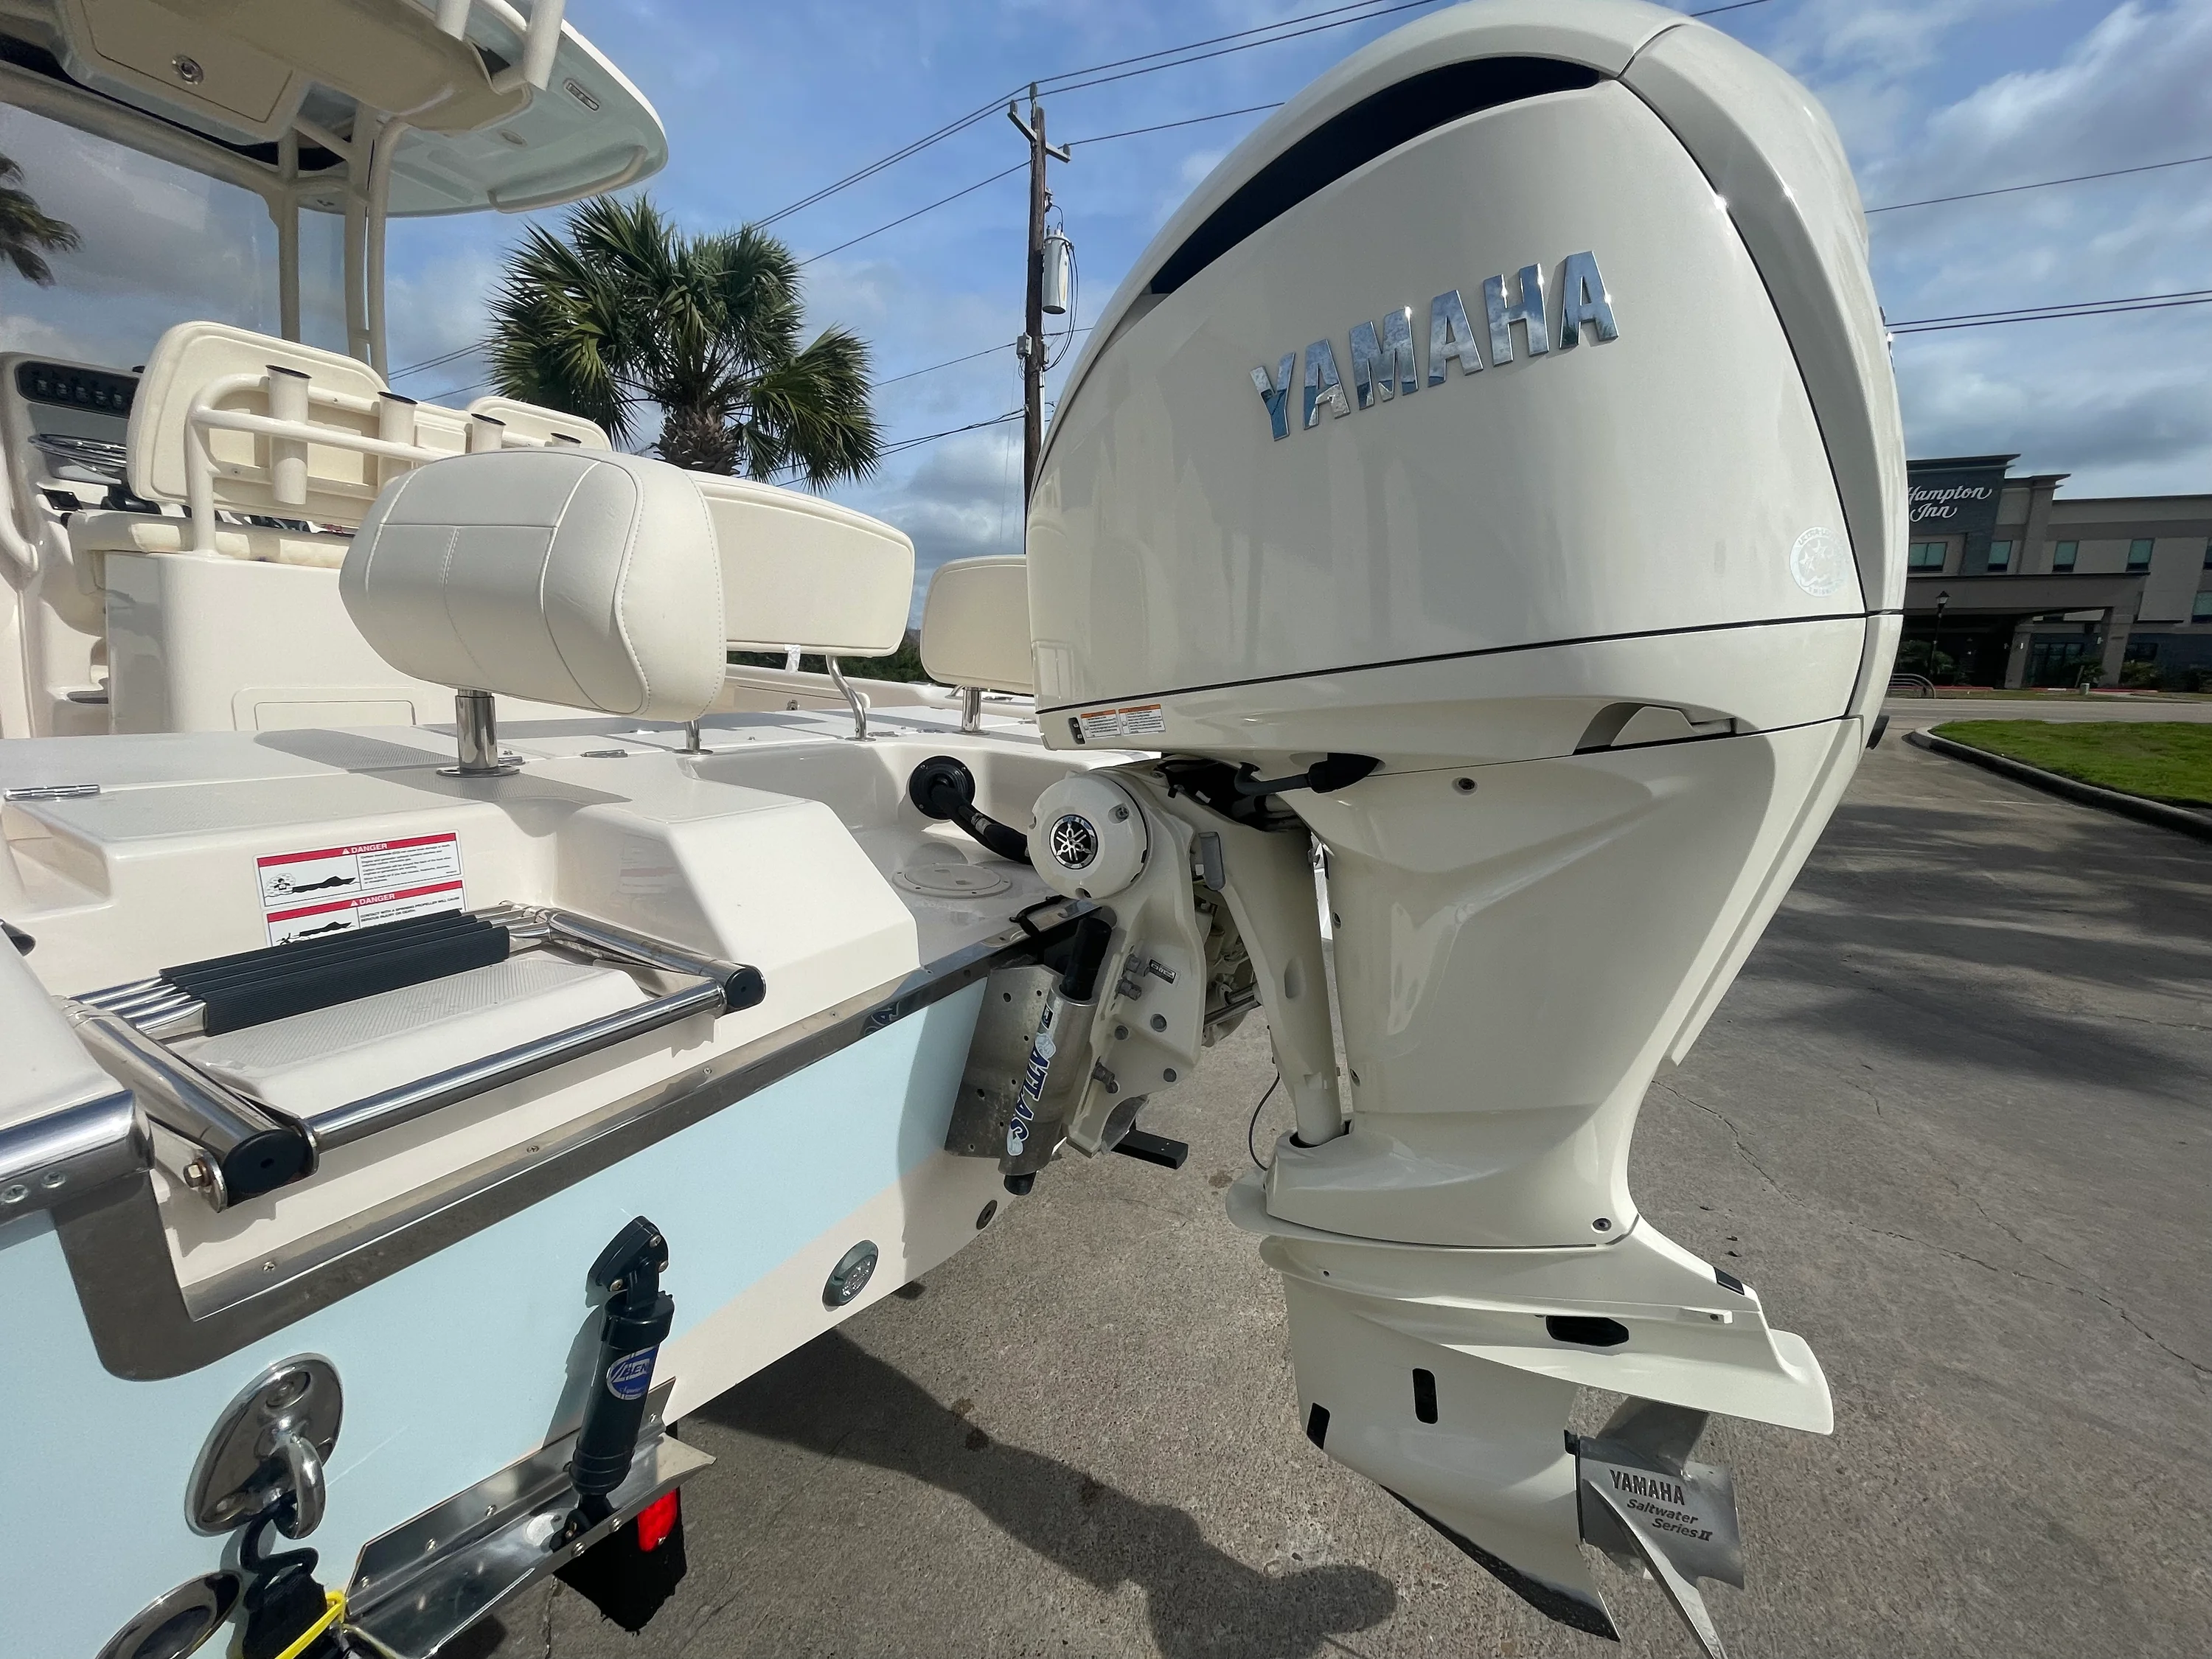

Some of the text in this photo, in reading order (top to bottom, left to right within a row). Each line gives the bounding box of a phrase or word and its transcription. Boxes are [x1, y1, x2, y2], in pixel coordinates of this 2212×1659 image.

[1249, 250, 1619, 442] YAMAHA
[1908, 485, 1993, 505] Hampton
[1910, 503, 1958, 522] Inn
[351, 843, 388, 854] DANGER
[359, 893, 395, 905] DANGER
[1010, 1040, 1048, 1143] ATLAS
[1610, 1469, 1686, 1506] YAMAHA
[1627, 1498, 1699, 1524] Saltwater
